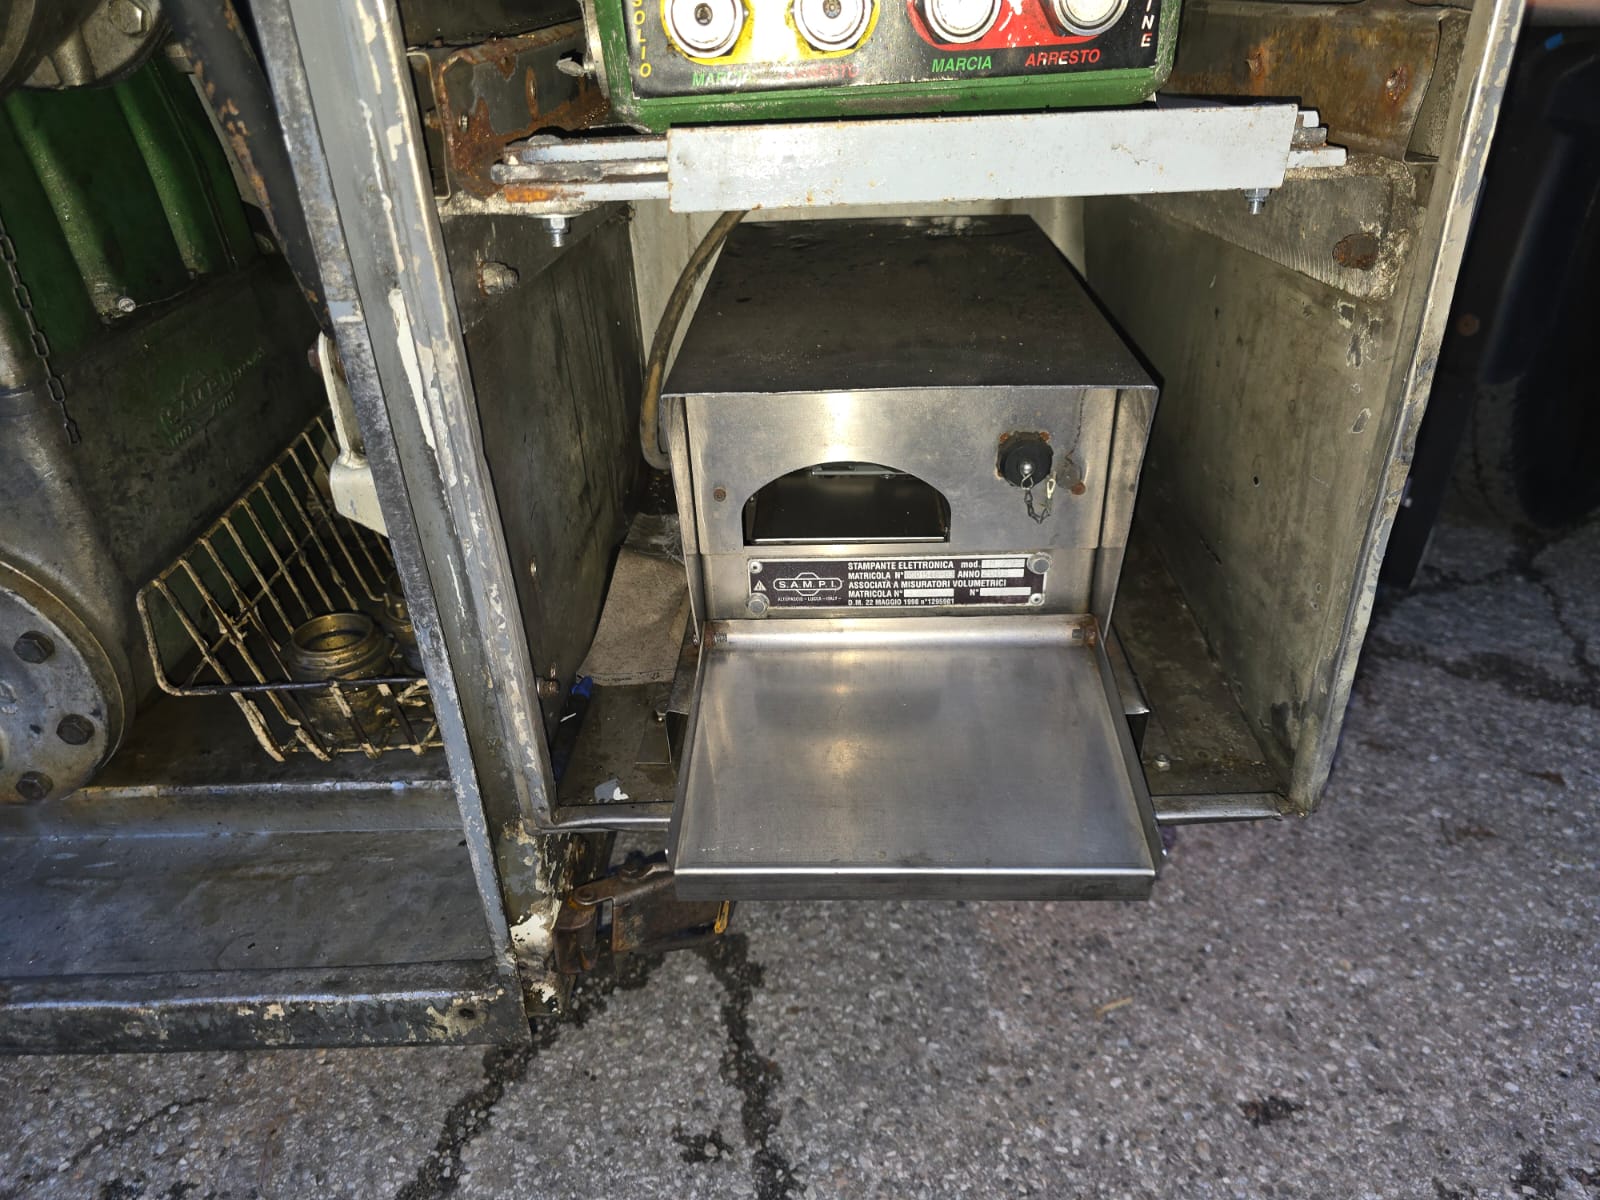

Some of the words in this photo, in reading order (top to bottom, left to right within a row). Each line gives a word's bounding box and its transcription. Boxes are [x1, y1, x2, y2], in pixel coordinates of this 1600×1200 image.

[1025, 48, 1101, 67] ARRESTO
[932, 56, 992, 73] MARCIA
[847, 561, 897, 570] STAMPANTE
[898, 560, 954, 569] ELETTRONICA
[960, 560, 981, 568] mod.
[847, 571, 891, 580] MATRICOLA
[957, 569, 980, 578] ANNO
[893, 580, 899, 588] A
[900, 580, 951, 588] MISURATORI
[952, 579, 1007, 588] VOLUMETRICI
[848, 589, 892, 598] MATRICOLA
[865, 598, 874, 606] 22
[874, 598, 902, 606] MAGGIO
